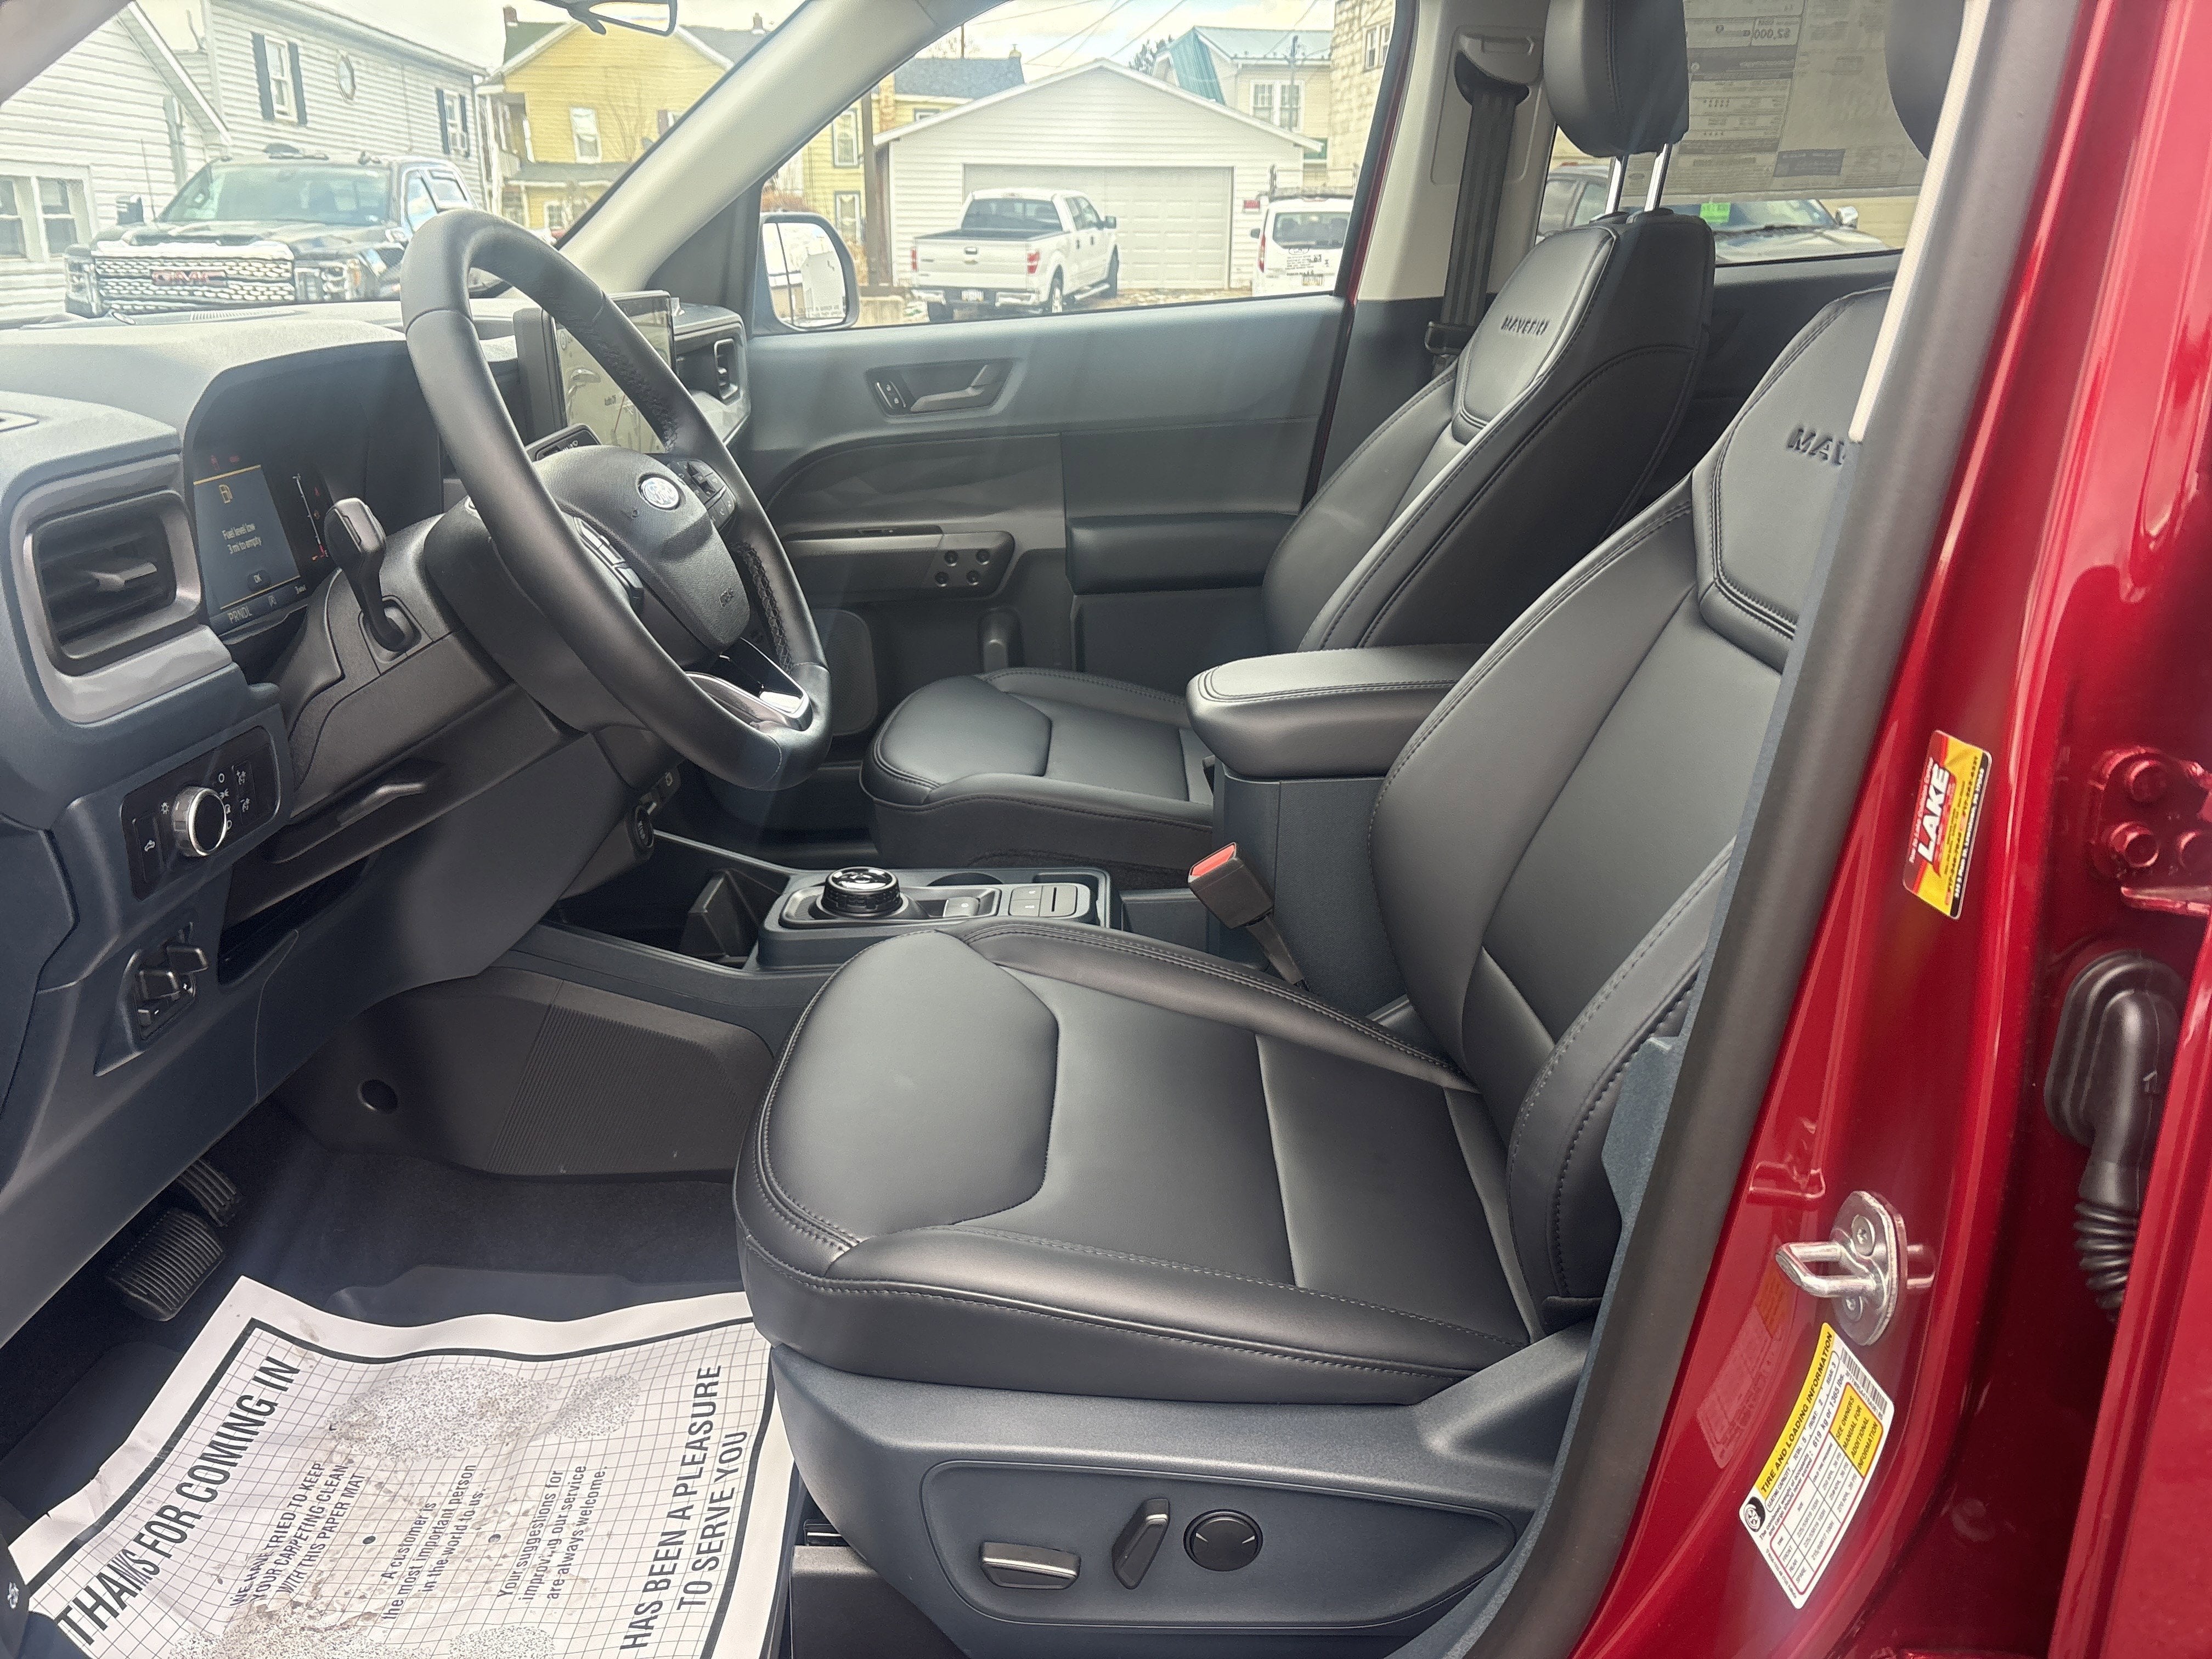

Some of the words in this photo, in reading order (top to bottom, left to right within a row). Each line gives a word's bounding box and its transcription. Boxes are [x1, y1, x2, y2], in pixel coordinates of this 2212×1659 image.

[151, 269, 226, 287] GMC
[222, 528, 234, 540] Fuel
[1918, 763, 1950, 862] LAKE
[672, 1364, 722, 1498] PLEASURE
[1760, 1469, 1776, 1492] TIRE
[1775, 1447, 1787, 1471] AND
[1785, 1402, 1809, 1449] LOADING
[1806, 1330, 1832, 1403] INFORMATION
[1767, 1488, 1779, 1509] SEATING
[1778, 1466, 1791, 1491] CAPACITY
[1818, 1397, 1823, 1407] 2
[1831, 1361, 1836, 1369] 3
[1812, 1430, 1822, 1448] 619
[1820, 1417, 1829, 1431] kg
[1825, 1407, 1832, 1419] or
[1829, 1385, 1839, 1408] 1365
[1836, 1372, 1845, 1387] lbs.
[1835, 1423, 1843, 1441] SEE
[1841, 1395, 1854, 1426] OWNERS
[1842, 1419, 1857, 1451] MANUAL
[1853, 1404, 1862, 1421] FOR
[1850, 1415, 1870, 1459] ADDITIONAL
[1857, 1421, 1878, 1471] INFORMATION
[133, 1504, 204, 1559] FOR
[175, 1394, 279, 1504] COMING
[252, 1356, 301, 1392] IN
[713, 1430, 748, 1483] YOU
[1765, 1503, 1781, 1531] combined
[1780, 1485, 1792, 1505] weight
[1793, 1452, 1809, 1481] occupants
[1774, 1509, 1784, 1526] cargo
[1782, 1491, 1794, 1511] should
[1793, 1477, 1802, 1493] never
[1801, 1457, 1812, 1477] exceed
[229, 1586, 247, 1606] WE
[264, 1512, 296, 1550] TRIED
[287, 1494, 308, 1510] TO
[298, 1463, 325, 1492] KEEP
[250, 1568, 282, 1602] YOUR
[273, 1505, 326, 1566] CARPETING
[316, 1465, 349, 1502] CLEAN
[276, 1569, 307, 1594] WITH
[297, 1543, 326, 1568] THIS
[317, 1502, 349, 1539] PAPER
[341, 1473, 365, 1498] MAT
[498, 1568, 523, 1598] Your
[516, 1493, 557, 1567] suggestions
[545, 1469, 564, 1490] for
[547, 1578, 566, 1600] are
[558, 1530, 585, 1575] always
[578, 1465, 608, 1526] welcome.
[552, 1513, 570, 1537] our
[564, 1465, 588, 1510] service
[666, 1504, 695, 1521] A
[691, 1486, 736, 1572] SERVE
[381, 1571, 396, 1579] A
[391, 1514, 429, 1568] customer
[419, 1502, 437, 1513] is
[381, 1599, 405, 1621] the
[397, 1565, 423, 1595] most
[417, 1508, 456, 1562] important
[448, 1464, 477, 1505] person
[418, 1579, 437, 1593] in
[432, 1558, 449, 1578] the
[443, 1525, 469, 1559] world
[459, 1509, 476, 1522] to
[642, 1529, 688, 1593] BEEN
[1782, 1544, 1792, 1562] FRONT
[1788, 1558, 1797, 1573] REAR
[1795, 1566, 1806, 1584] SPARE
[619, 1599, 664, 1650] HAS
[675, 1580, 713, 1611] TO
